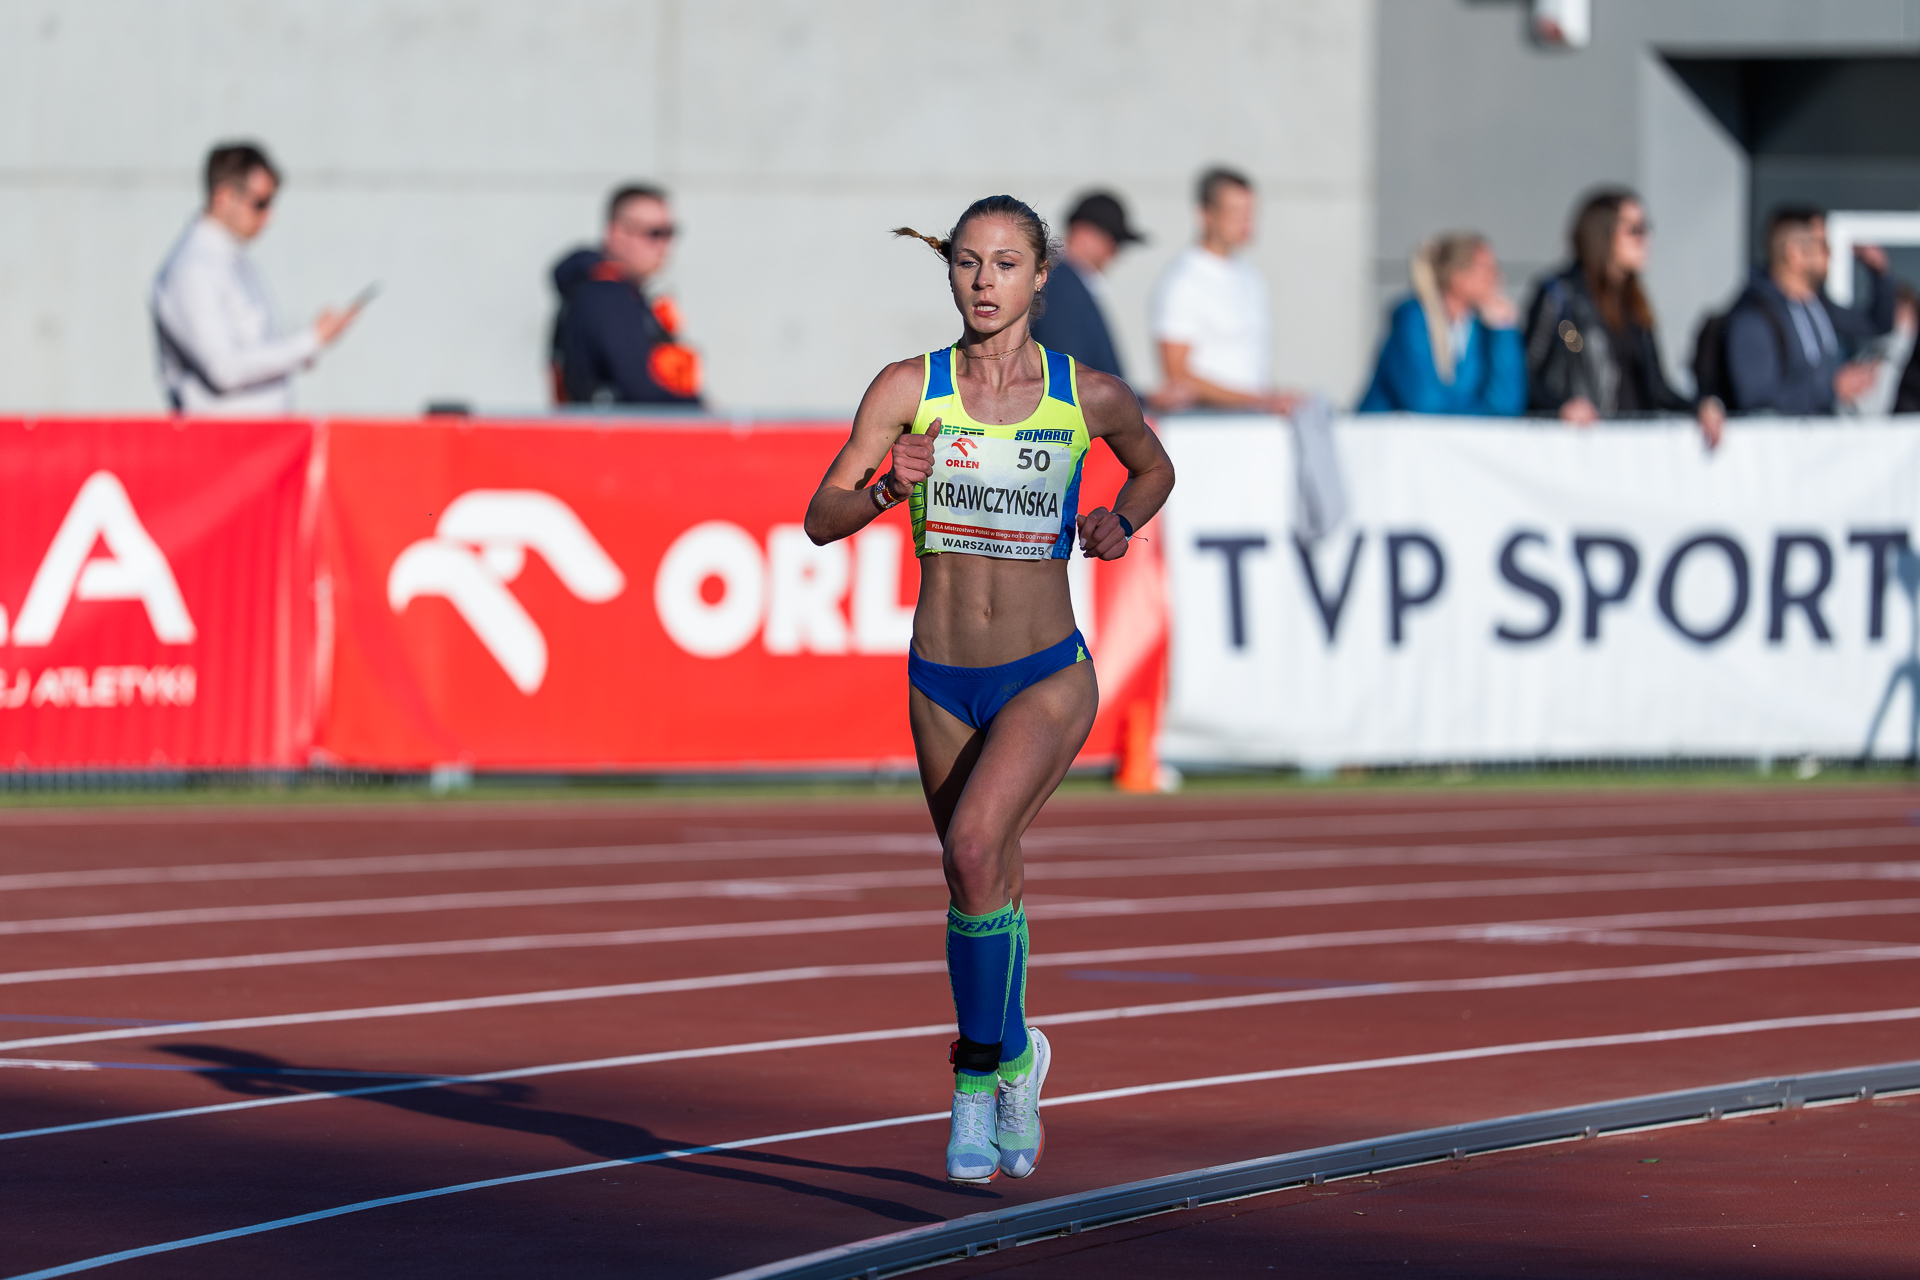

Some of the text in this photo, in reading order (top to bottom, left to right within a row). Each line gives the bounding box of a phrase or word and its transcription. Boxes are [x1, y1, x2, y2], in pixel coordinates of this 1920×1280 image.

[945, 458, 980, 470] ORLEN
[1016, 448, 1051, 472] 50
[933, 481, 1059, 518] KRAWCZYŃSKA
[944, 525, 975, 534] Mistrzostwa
[975, 528, 990, 536] Polski
[996, 531, 1011, 539] Biegu
[942, 537, 1045, 556] WARSZAWA 2025
[1195, 528, 1909, 649] TVP SPORT
